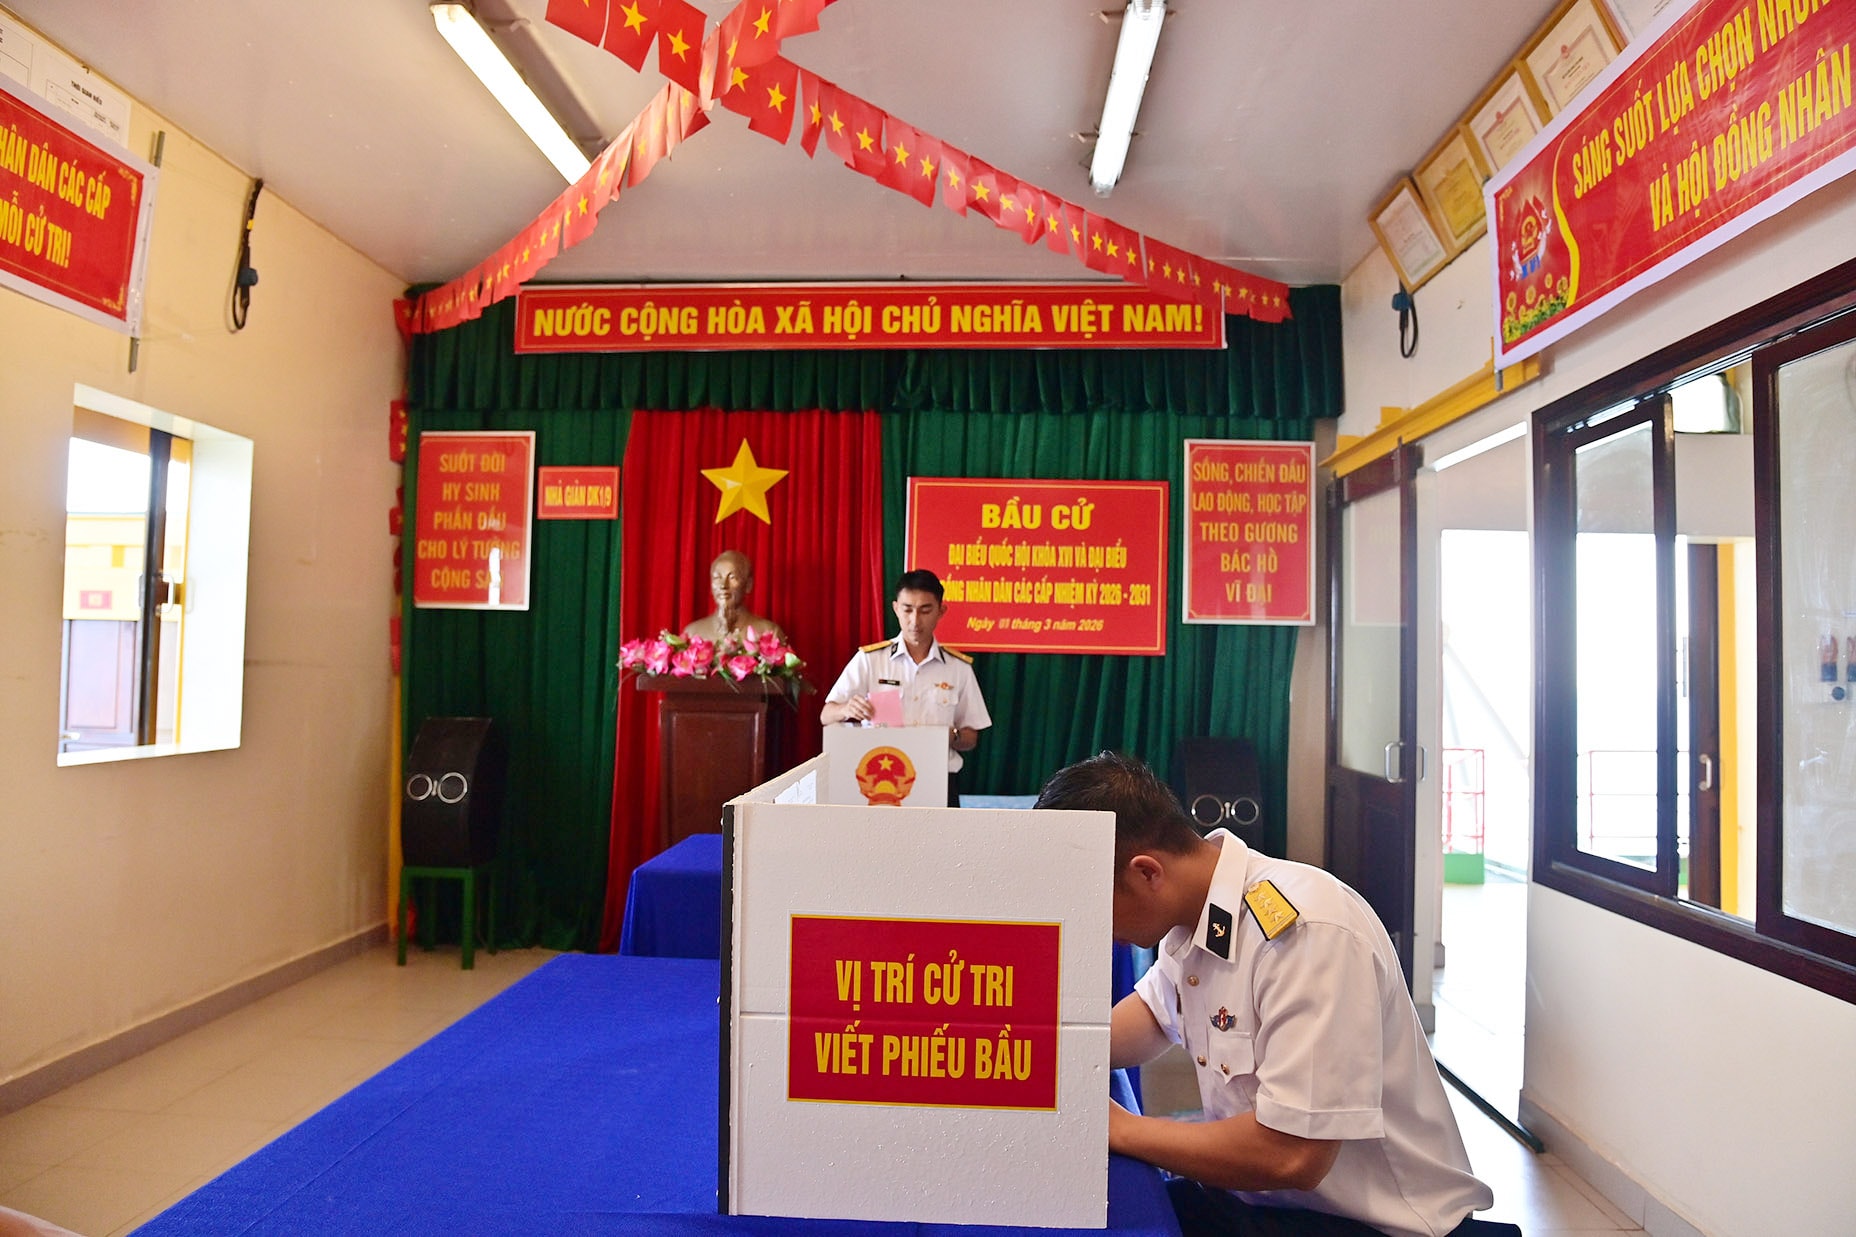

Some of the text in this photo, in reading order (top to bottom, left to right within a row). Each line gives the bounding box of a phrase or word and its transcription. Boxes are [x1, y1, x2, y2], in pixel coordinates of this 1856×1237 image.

[1572, 129, 1612, 199] SÁNG
[1613, 79, 1655, 166] SUỐT
[1657, 60, 1695, 136] LỰA
[1696, 6, 1754, 92] CHỌN
[1650, 43, 1852, 232] VÀ HỘI ĐỒNG NHÂN
[0, 124, 112, 220] HÂN DÂN CÁC CẤP
[24, 204, 47, 256] CỬ
[46, 222, 72, 268] TRI!
[533, 296, 1204, 340] NƯỚC CỘNG HÒA XÃ HỘI CHỦ NGHĨA VIỆT NAM!
[440, 449, 506, 472] SUỐT ĐỜI
[1193, 456, 1306, 485] SỐNG, CHIẾN ĐẤU
[442, 482, 500, 502] HY SINH
[545, 480, 562, 506] NHÀ
[1192, 490, 1306, 516] LAO ĐỘNG, HỌC TẬP
[434, 504, 472, 530] PHẤN
[982, 496, 1095, 530] BẦU CỬ
[1200, 522, 1298, 543] THEO GƯƠNG
[418, 540, 447, 559] CHO
[452, 537, 468, 560] LÝ
[948, 536, 1127, 573] ĐẠI BIỂU QUỐC HỘI KHÓA XVI VÀ ĐẠI BIỂU
[1220, 546, 1278, 574] BÁC HỒ
[432, 566, 470, 591] CỘNG
[966, 576, 992, 602] NHÂN
[993, 576, 1012, 603] DÂN
[1014, 577, 1033, 604] CÁC
[1034, 574, 1053, 604] CẤP
[1054, 578, 1084, 609] NHIỆM
[1086, 578, 1098, 604] KỲ
[1099, 583, 1122, 606] 2026
[1129, 584, 1151, 606] 2031
[1226, 580, 1272, 606] VĨ ĐẠI
[966, 617, 995, 632] Ngày
[1011, 618, 1042, 632] tháng
[1043, 618, 1052, 630] 3
[1052, 619, 1076, 630] năm
[1078, 618, 1104, 632] 2026
[835, 949, 1014, 1012] VỊ TRÍ CỬ TRI
[814, 1020, 1032, 1081] VIẾT PHIẾU BẦU
